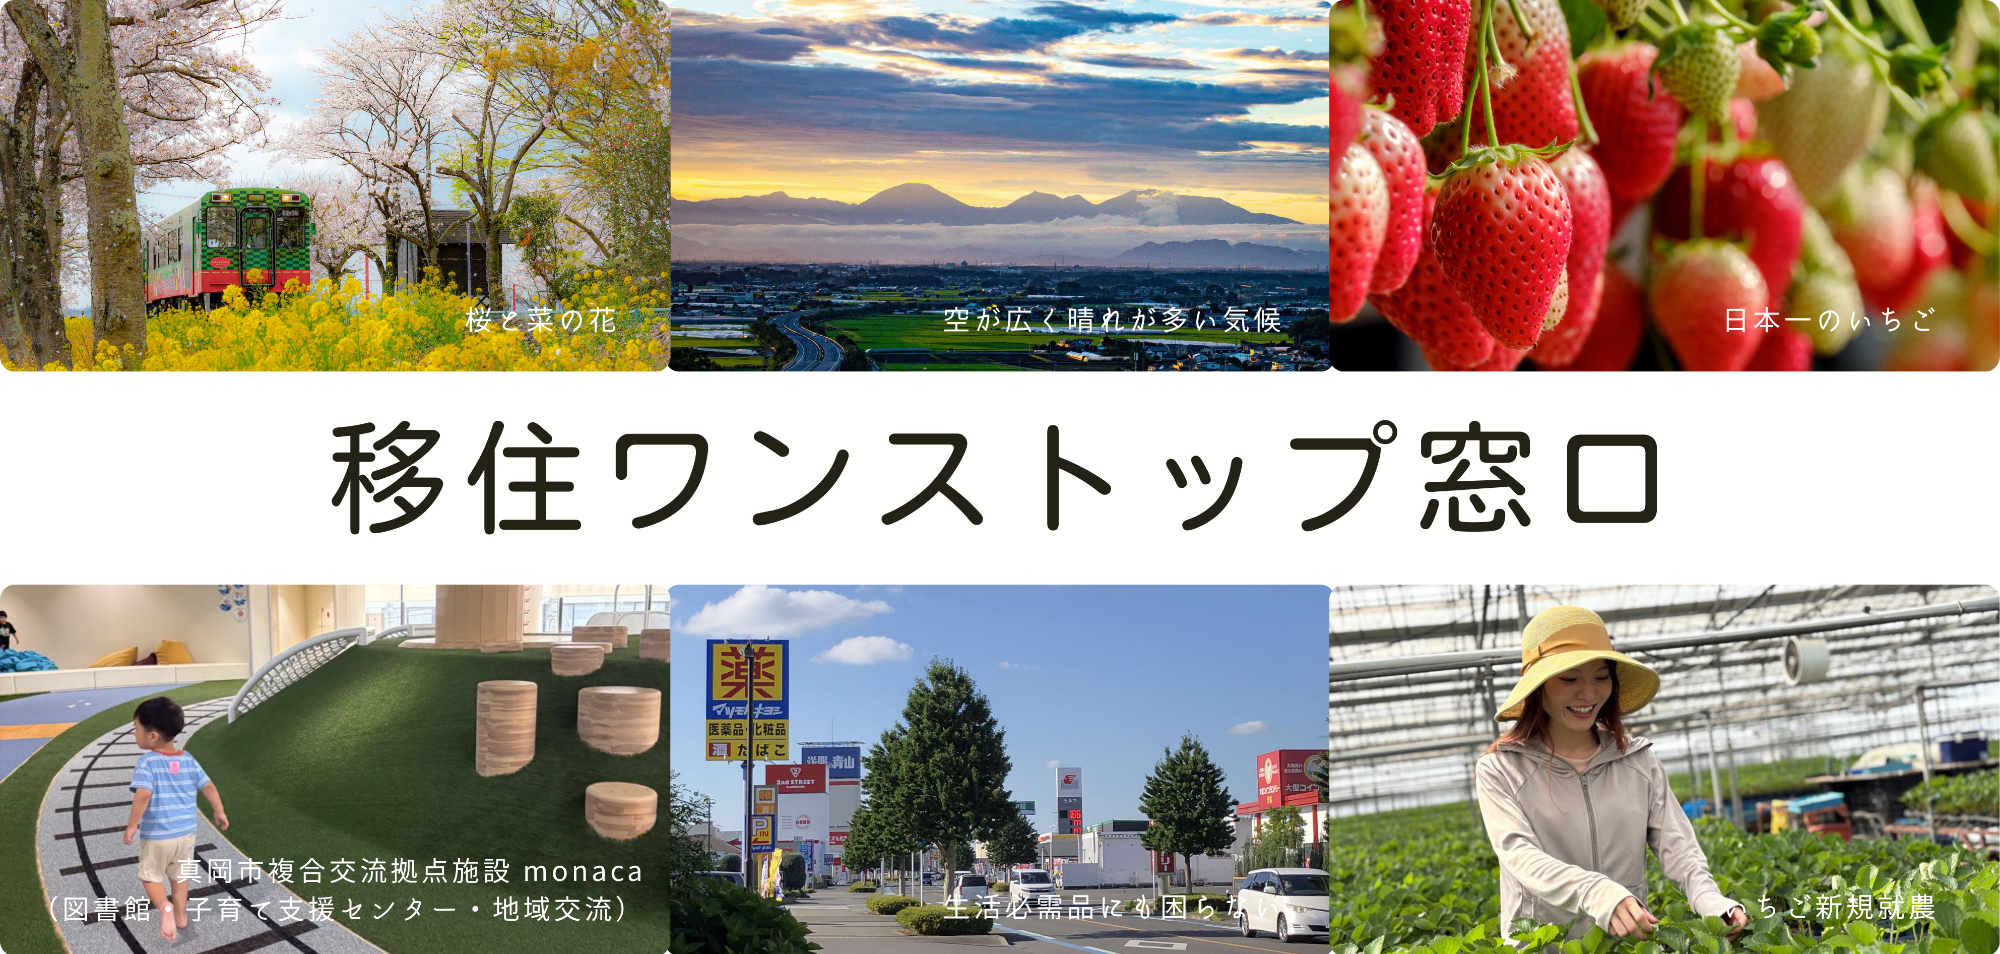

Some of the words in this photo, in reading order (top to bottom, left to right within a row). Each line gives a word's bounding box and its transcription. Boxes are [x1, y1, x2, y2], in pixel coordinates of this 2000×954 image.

[721, 646, 776, 699] 薬
[712, 742, 728, 757] 酒
[752, 817, 769, 837] P
